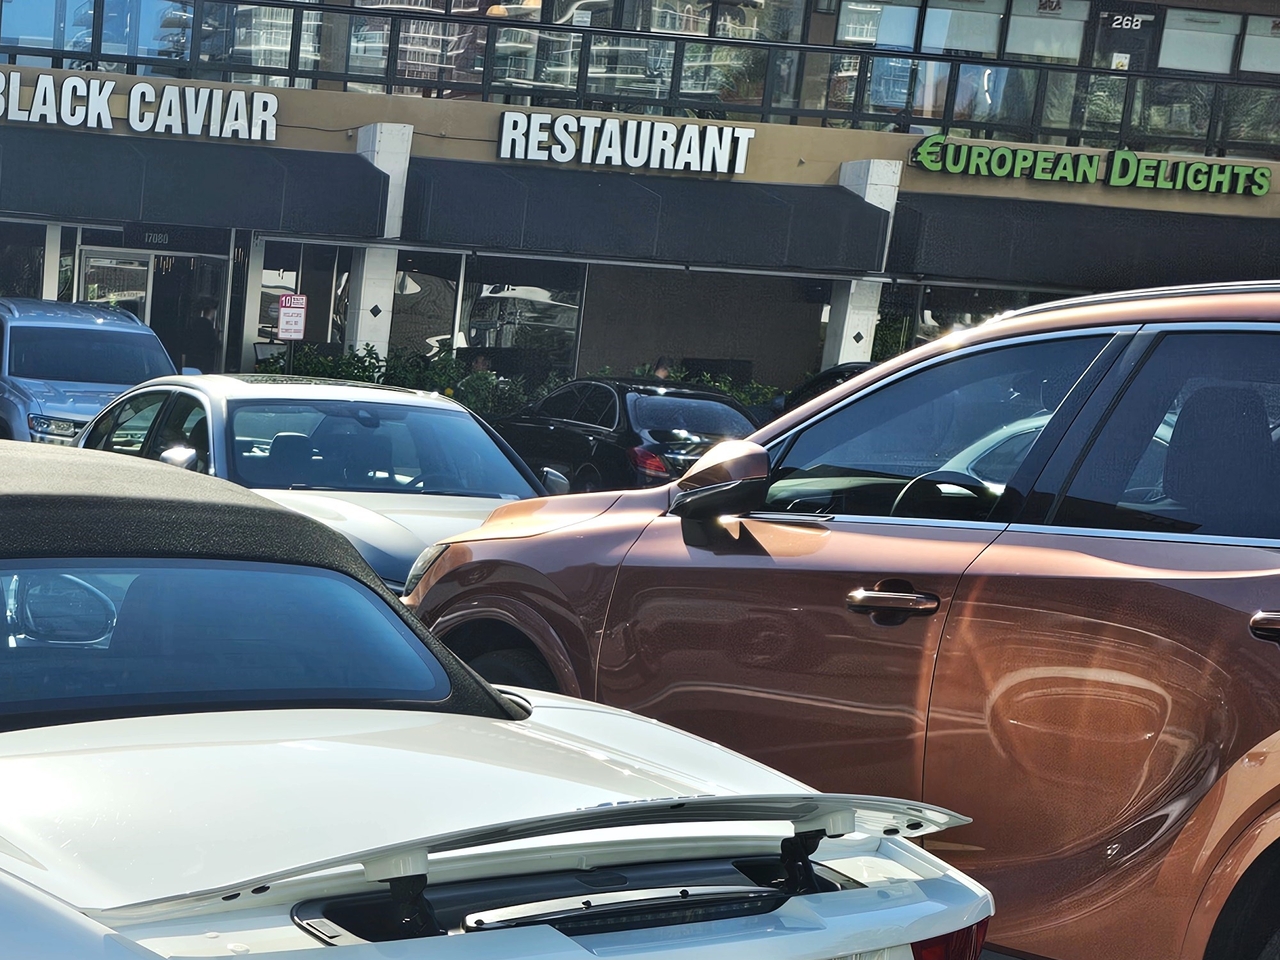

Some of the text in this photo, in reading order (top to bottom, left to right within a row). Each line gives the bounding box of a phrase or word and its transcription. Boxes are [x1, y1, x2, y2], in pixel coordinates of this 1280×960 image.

[1111, 15, 1142, 30] 268
[128, 82, 279, 141] CAVIAR
[499, 111, 756, 174] RESTAURANT
[1109, 149, 1272, 196] DELIGHTS
[145, 232, 169, 244] 17080
[281, 296, 292, 307] 10
